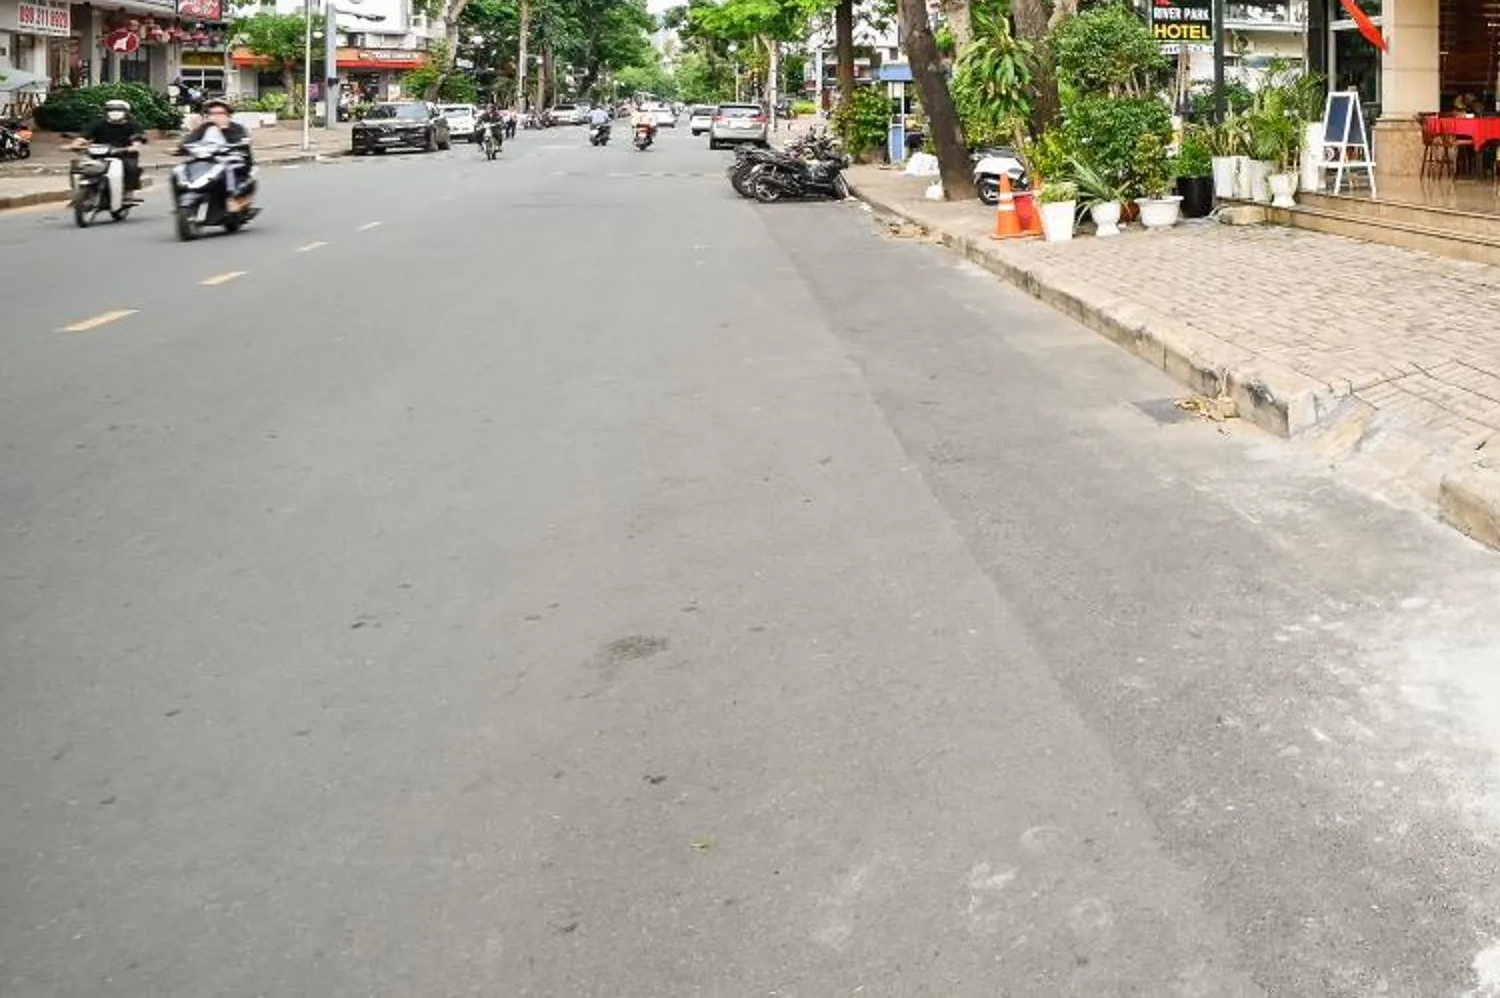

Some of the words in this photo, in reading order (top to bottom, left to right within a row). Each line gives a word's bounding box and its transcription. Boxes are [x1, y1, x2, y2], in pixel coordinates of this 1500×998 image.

[1153, 7, 1181, 20] RIVER
[1184, 7, 1210, 21] PARK
[1154, 24, 1210, 39] HOTEL
